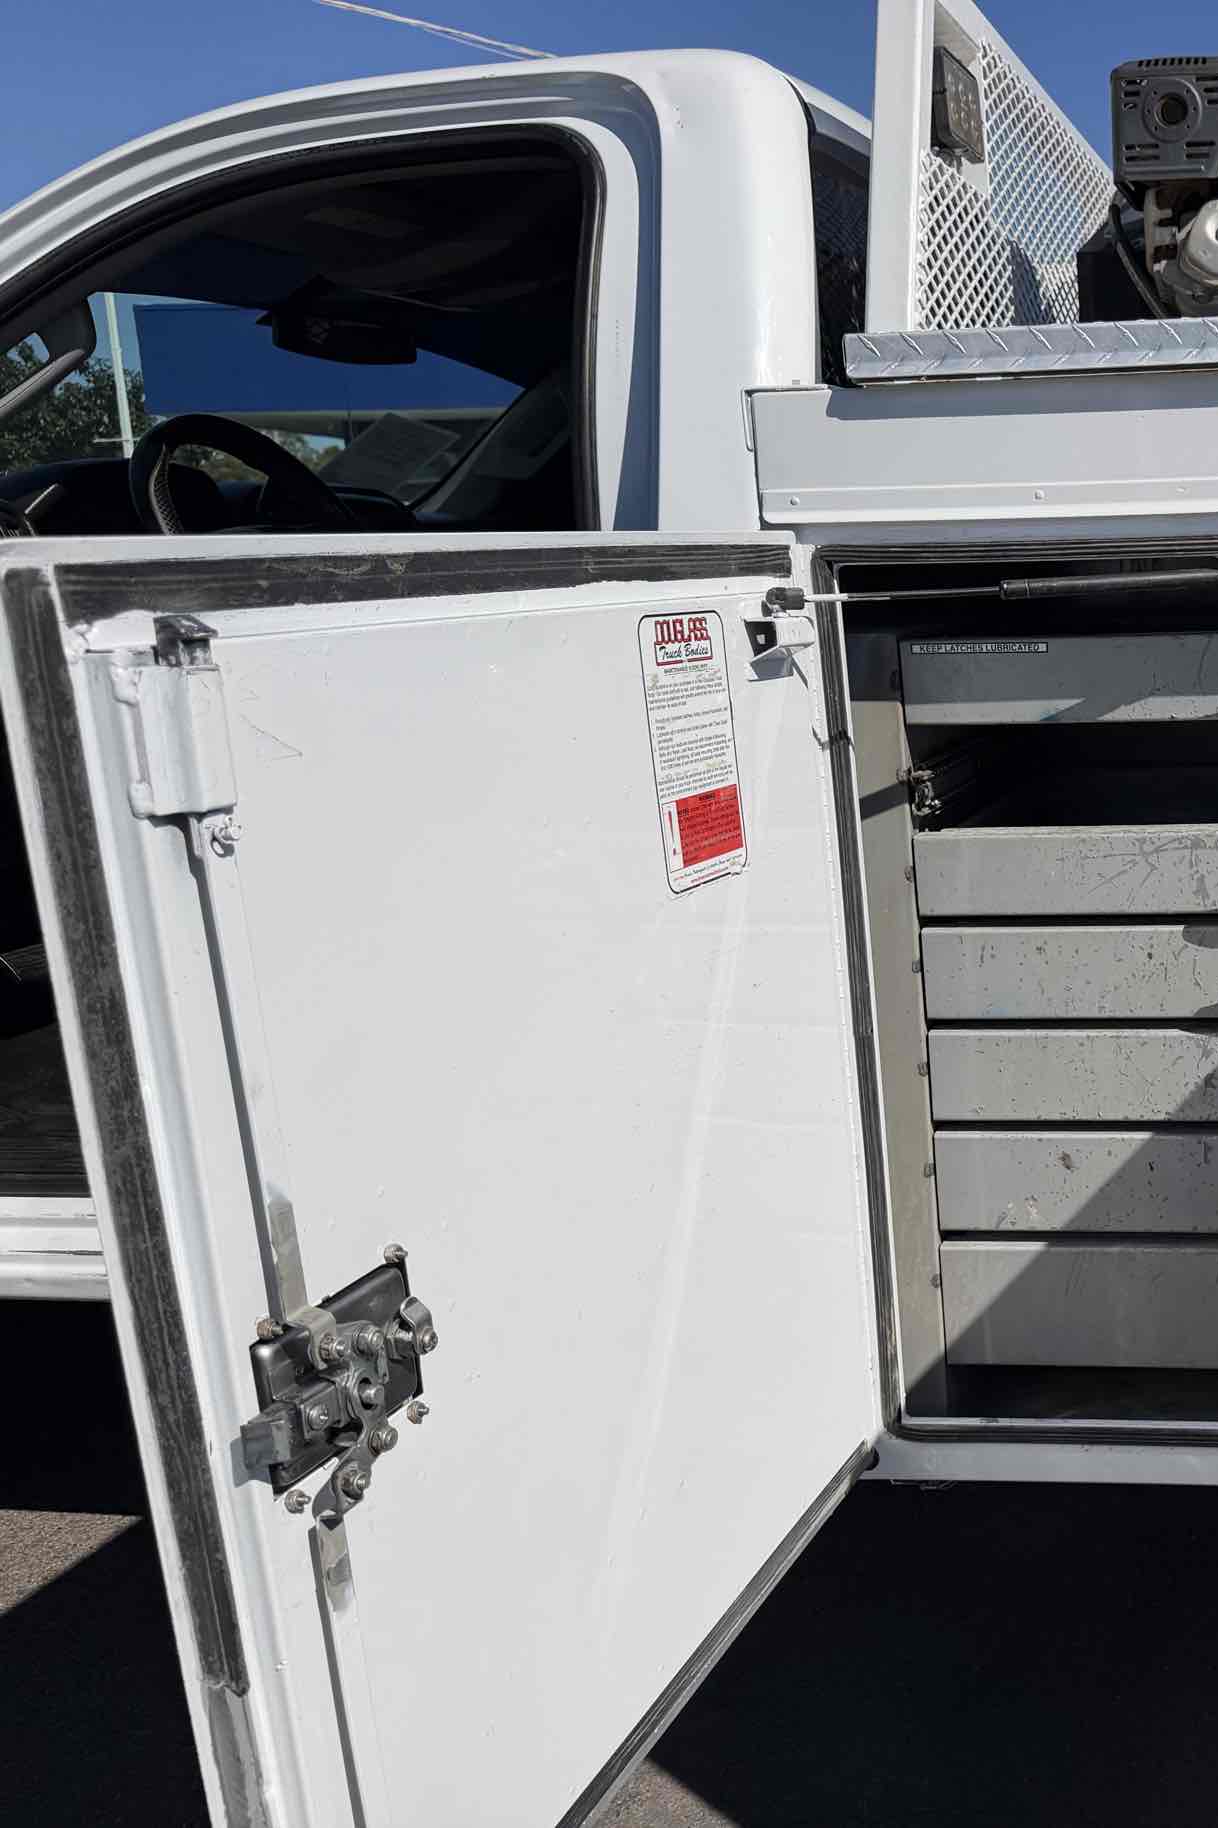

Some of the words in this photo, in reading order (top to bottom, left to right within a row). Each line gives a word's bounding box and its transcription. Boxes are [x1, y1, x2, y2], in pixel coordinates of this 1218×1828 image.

[659, 644, 682, 661] Truck
[684, 641, 710, 657] Bodies
[919, 643, 943, 653] KEEP
[944, 643, 984, 653] LATCHES
[986, 642, 1040, 653] LUBRICATED
